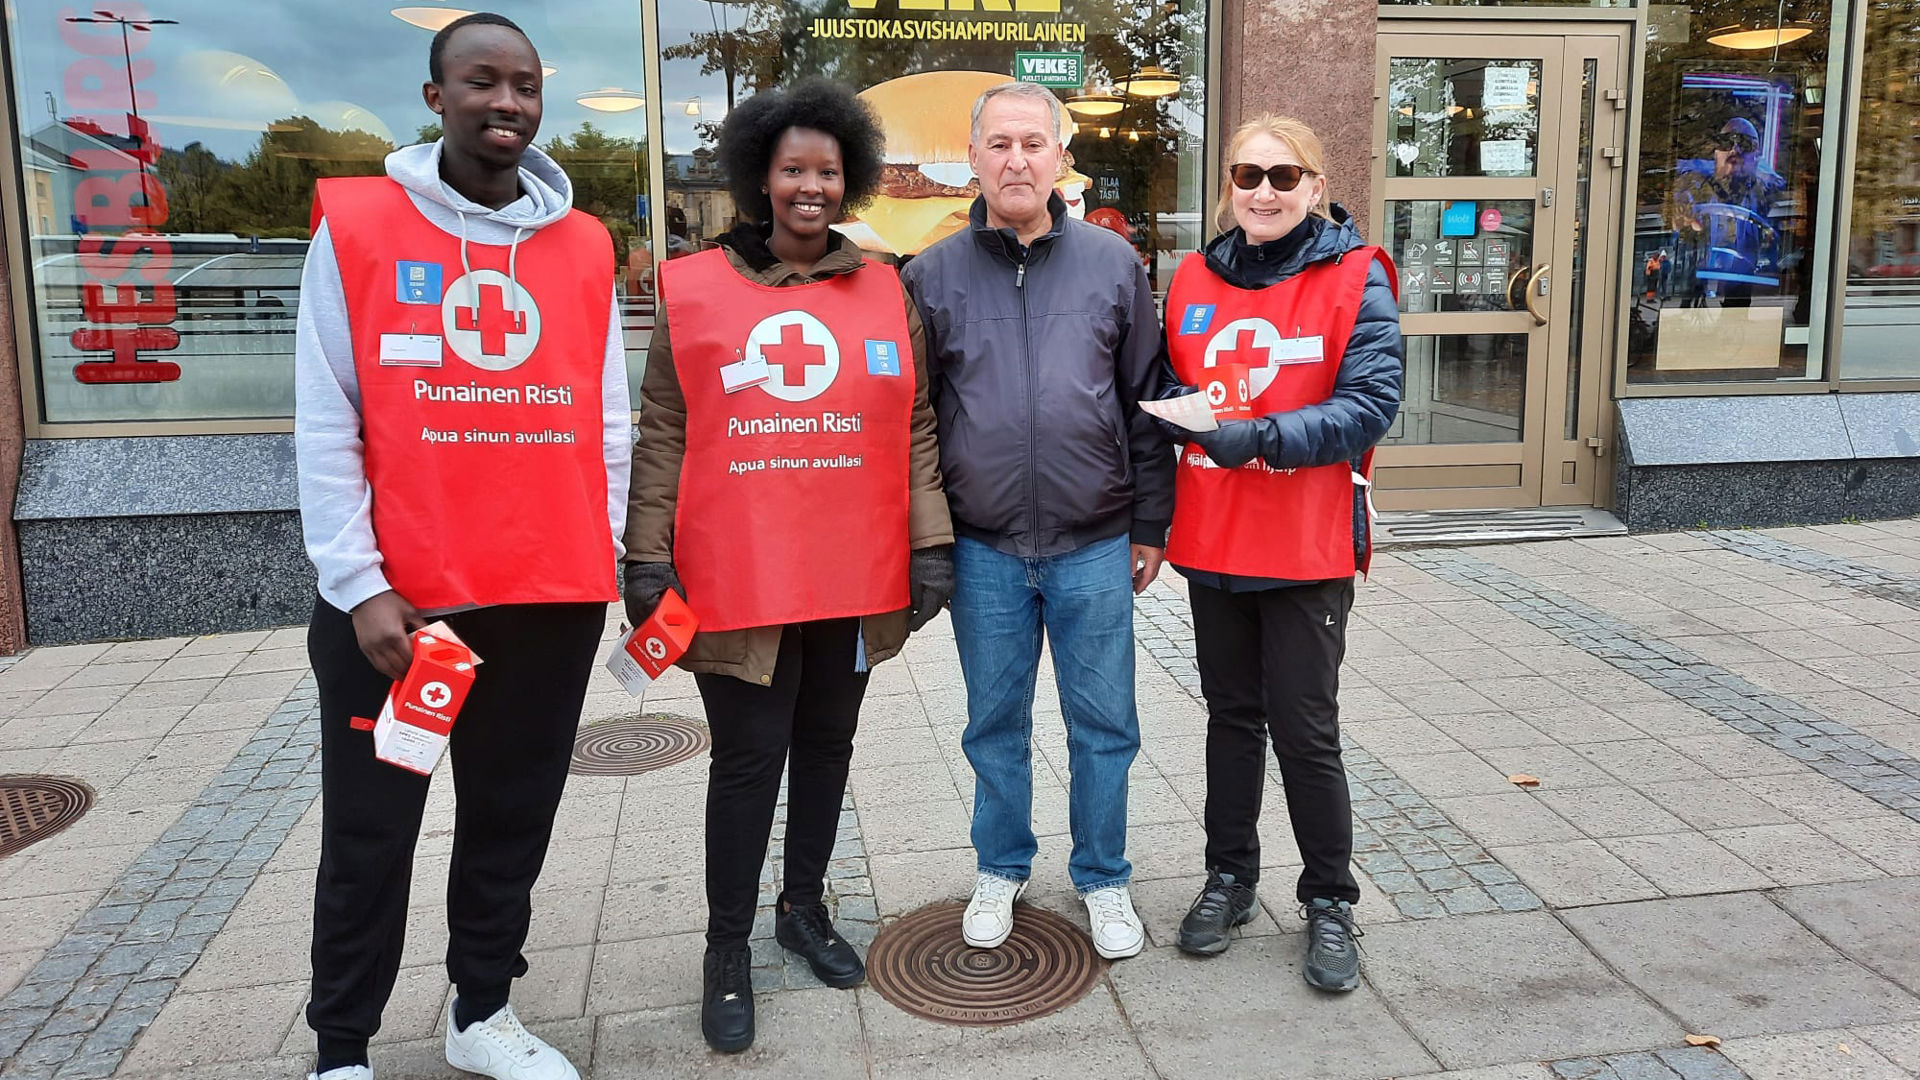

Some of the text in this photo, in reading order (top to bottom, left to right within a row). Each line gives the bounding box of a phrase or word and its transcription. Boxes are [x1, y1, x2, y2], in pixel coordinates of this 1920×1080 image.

[807, 18, 1086, 42] -JUUSTOKASVISHAMPURILAINEN
[1022, 58, 1068, 74] VEKE
[1068, 59, 1077, 82] 2030
[413, 379, 573, 406] Punainen Risti
[421, 427, 575, 445] Apua sinun avullasi
[728, 412, 862, 438] Punainen Risti
[728, 454, 862, 476] Apua sinun avullasi
